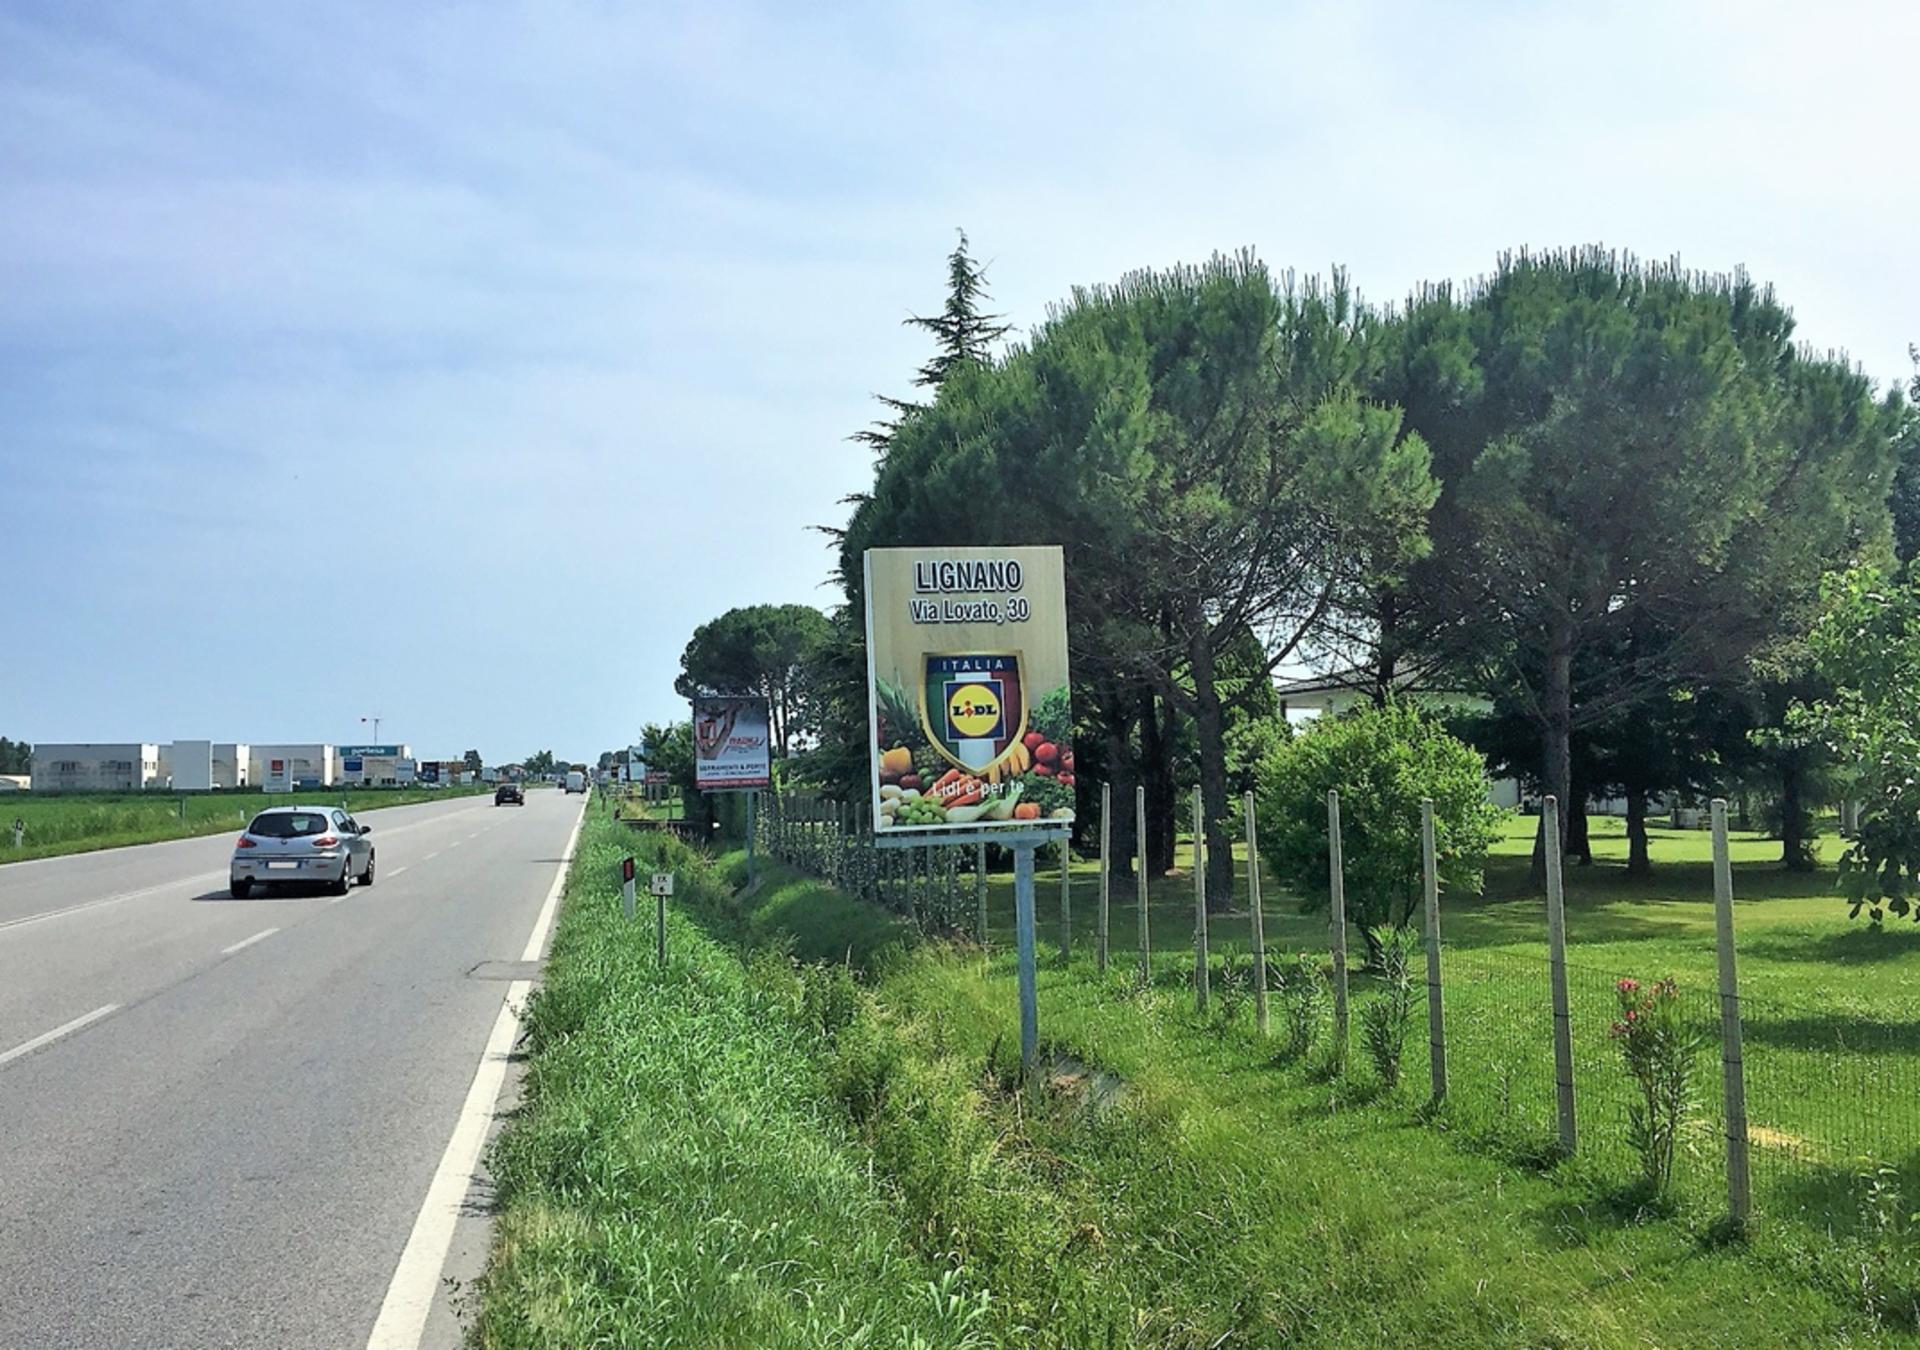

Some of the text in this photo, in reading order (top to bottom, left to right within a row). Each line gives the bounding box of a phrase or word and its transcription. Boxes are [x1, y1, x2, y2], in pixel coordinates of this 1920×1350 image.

[915, 560, 1023, 592] LIGNANO
[911, 597, 1030, 625] Via Lovato, 30
[942, 659, 1004, 671] ITALIA
[933, 781, 960, 797] Lidl
[980, 782, 1004, 798] per
[1010, 779, 1025, 793] te
